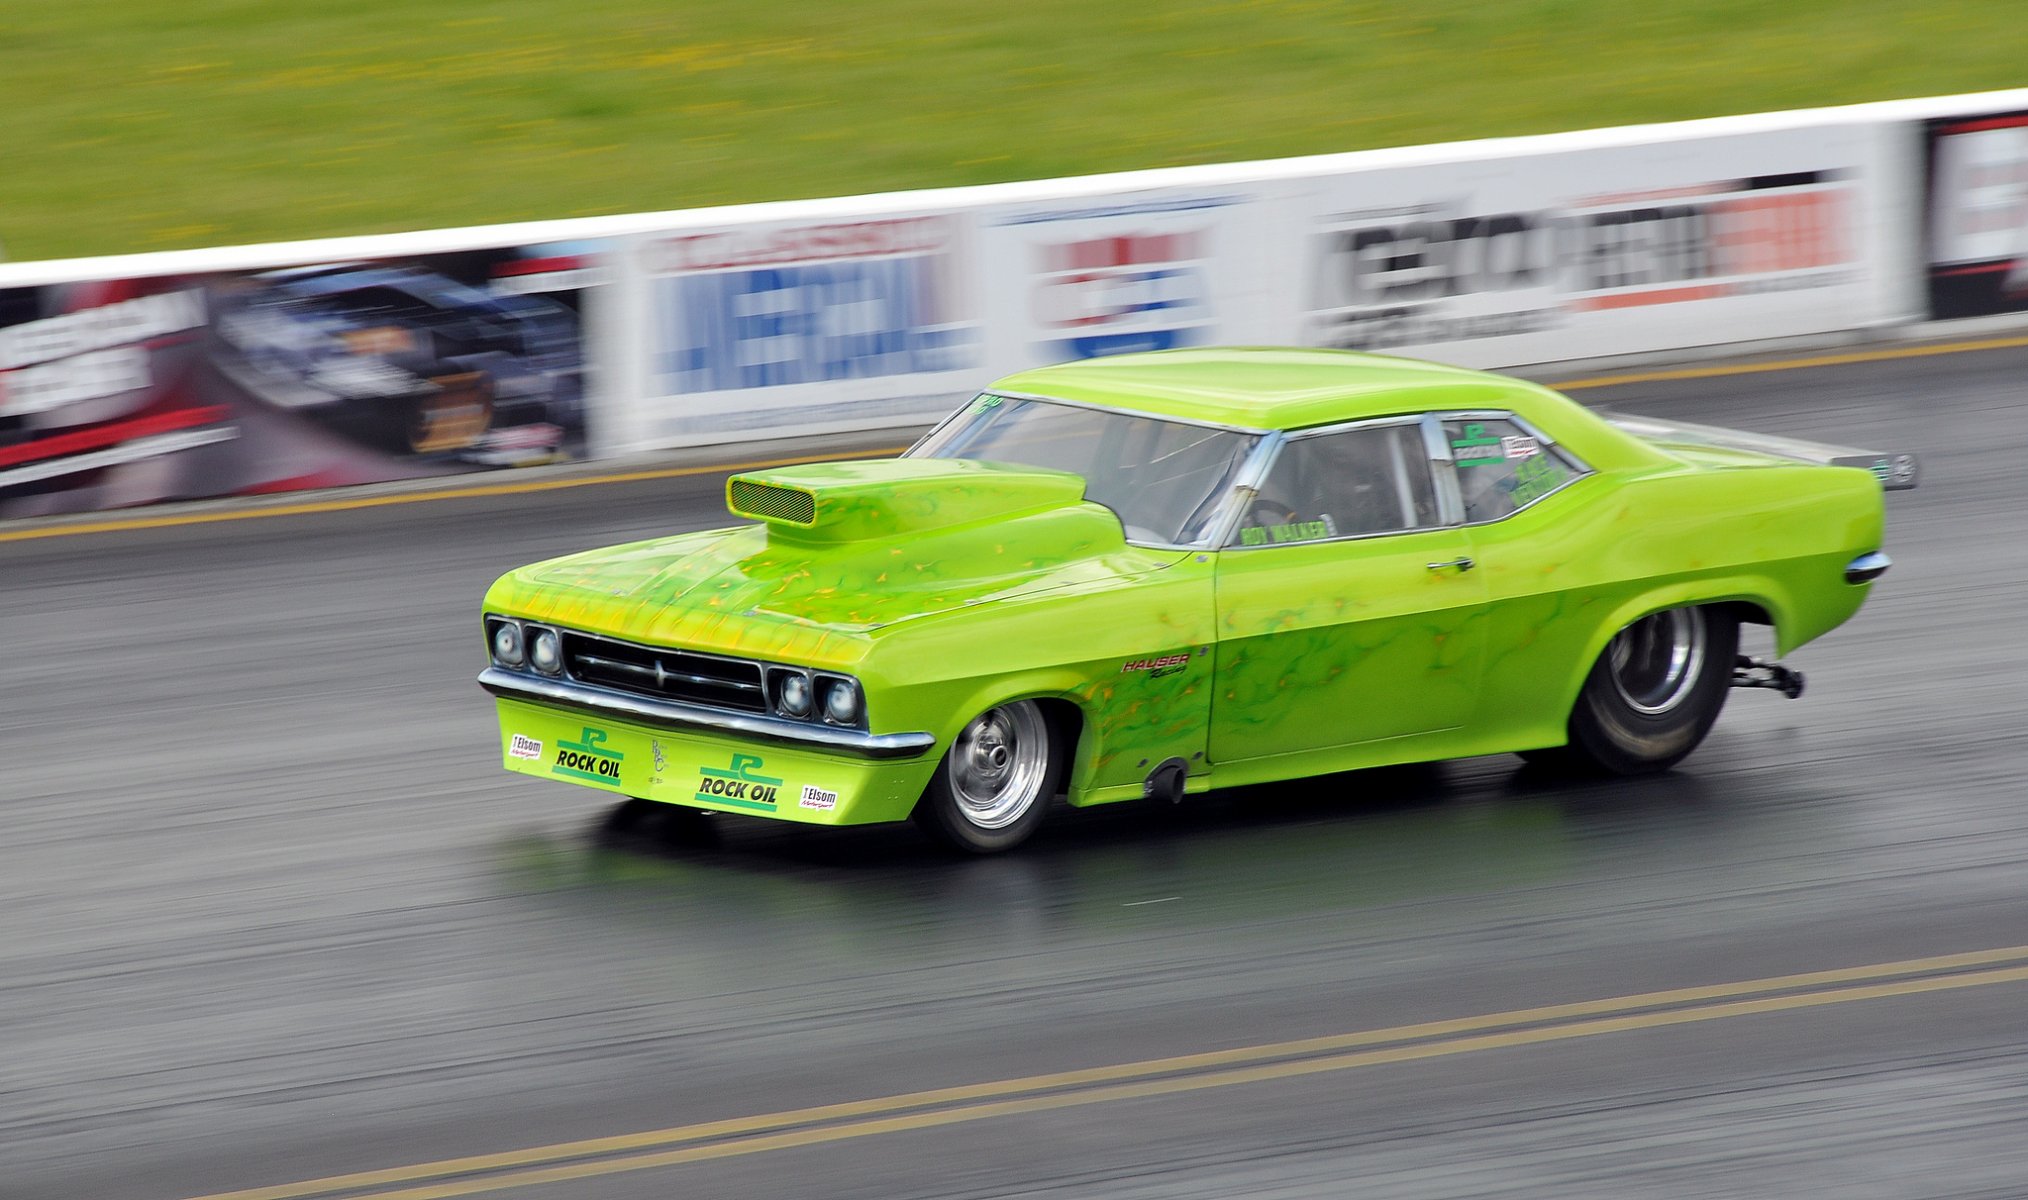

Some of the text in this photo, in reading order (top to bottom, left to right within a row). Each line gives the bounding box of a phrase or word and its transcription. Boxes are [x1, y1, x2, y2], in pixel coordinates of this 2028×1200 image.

[1121, 653, 1190, 672] HAUSER
[517, 737, 541, 752] Elsom
[556, 750, 620, 778] ROCK OIL
[699, 777, 778, 803] ROCK OIL
[808, 788, 836, 804] Elsom
